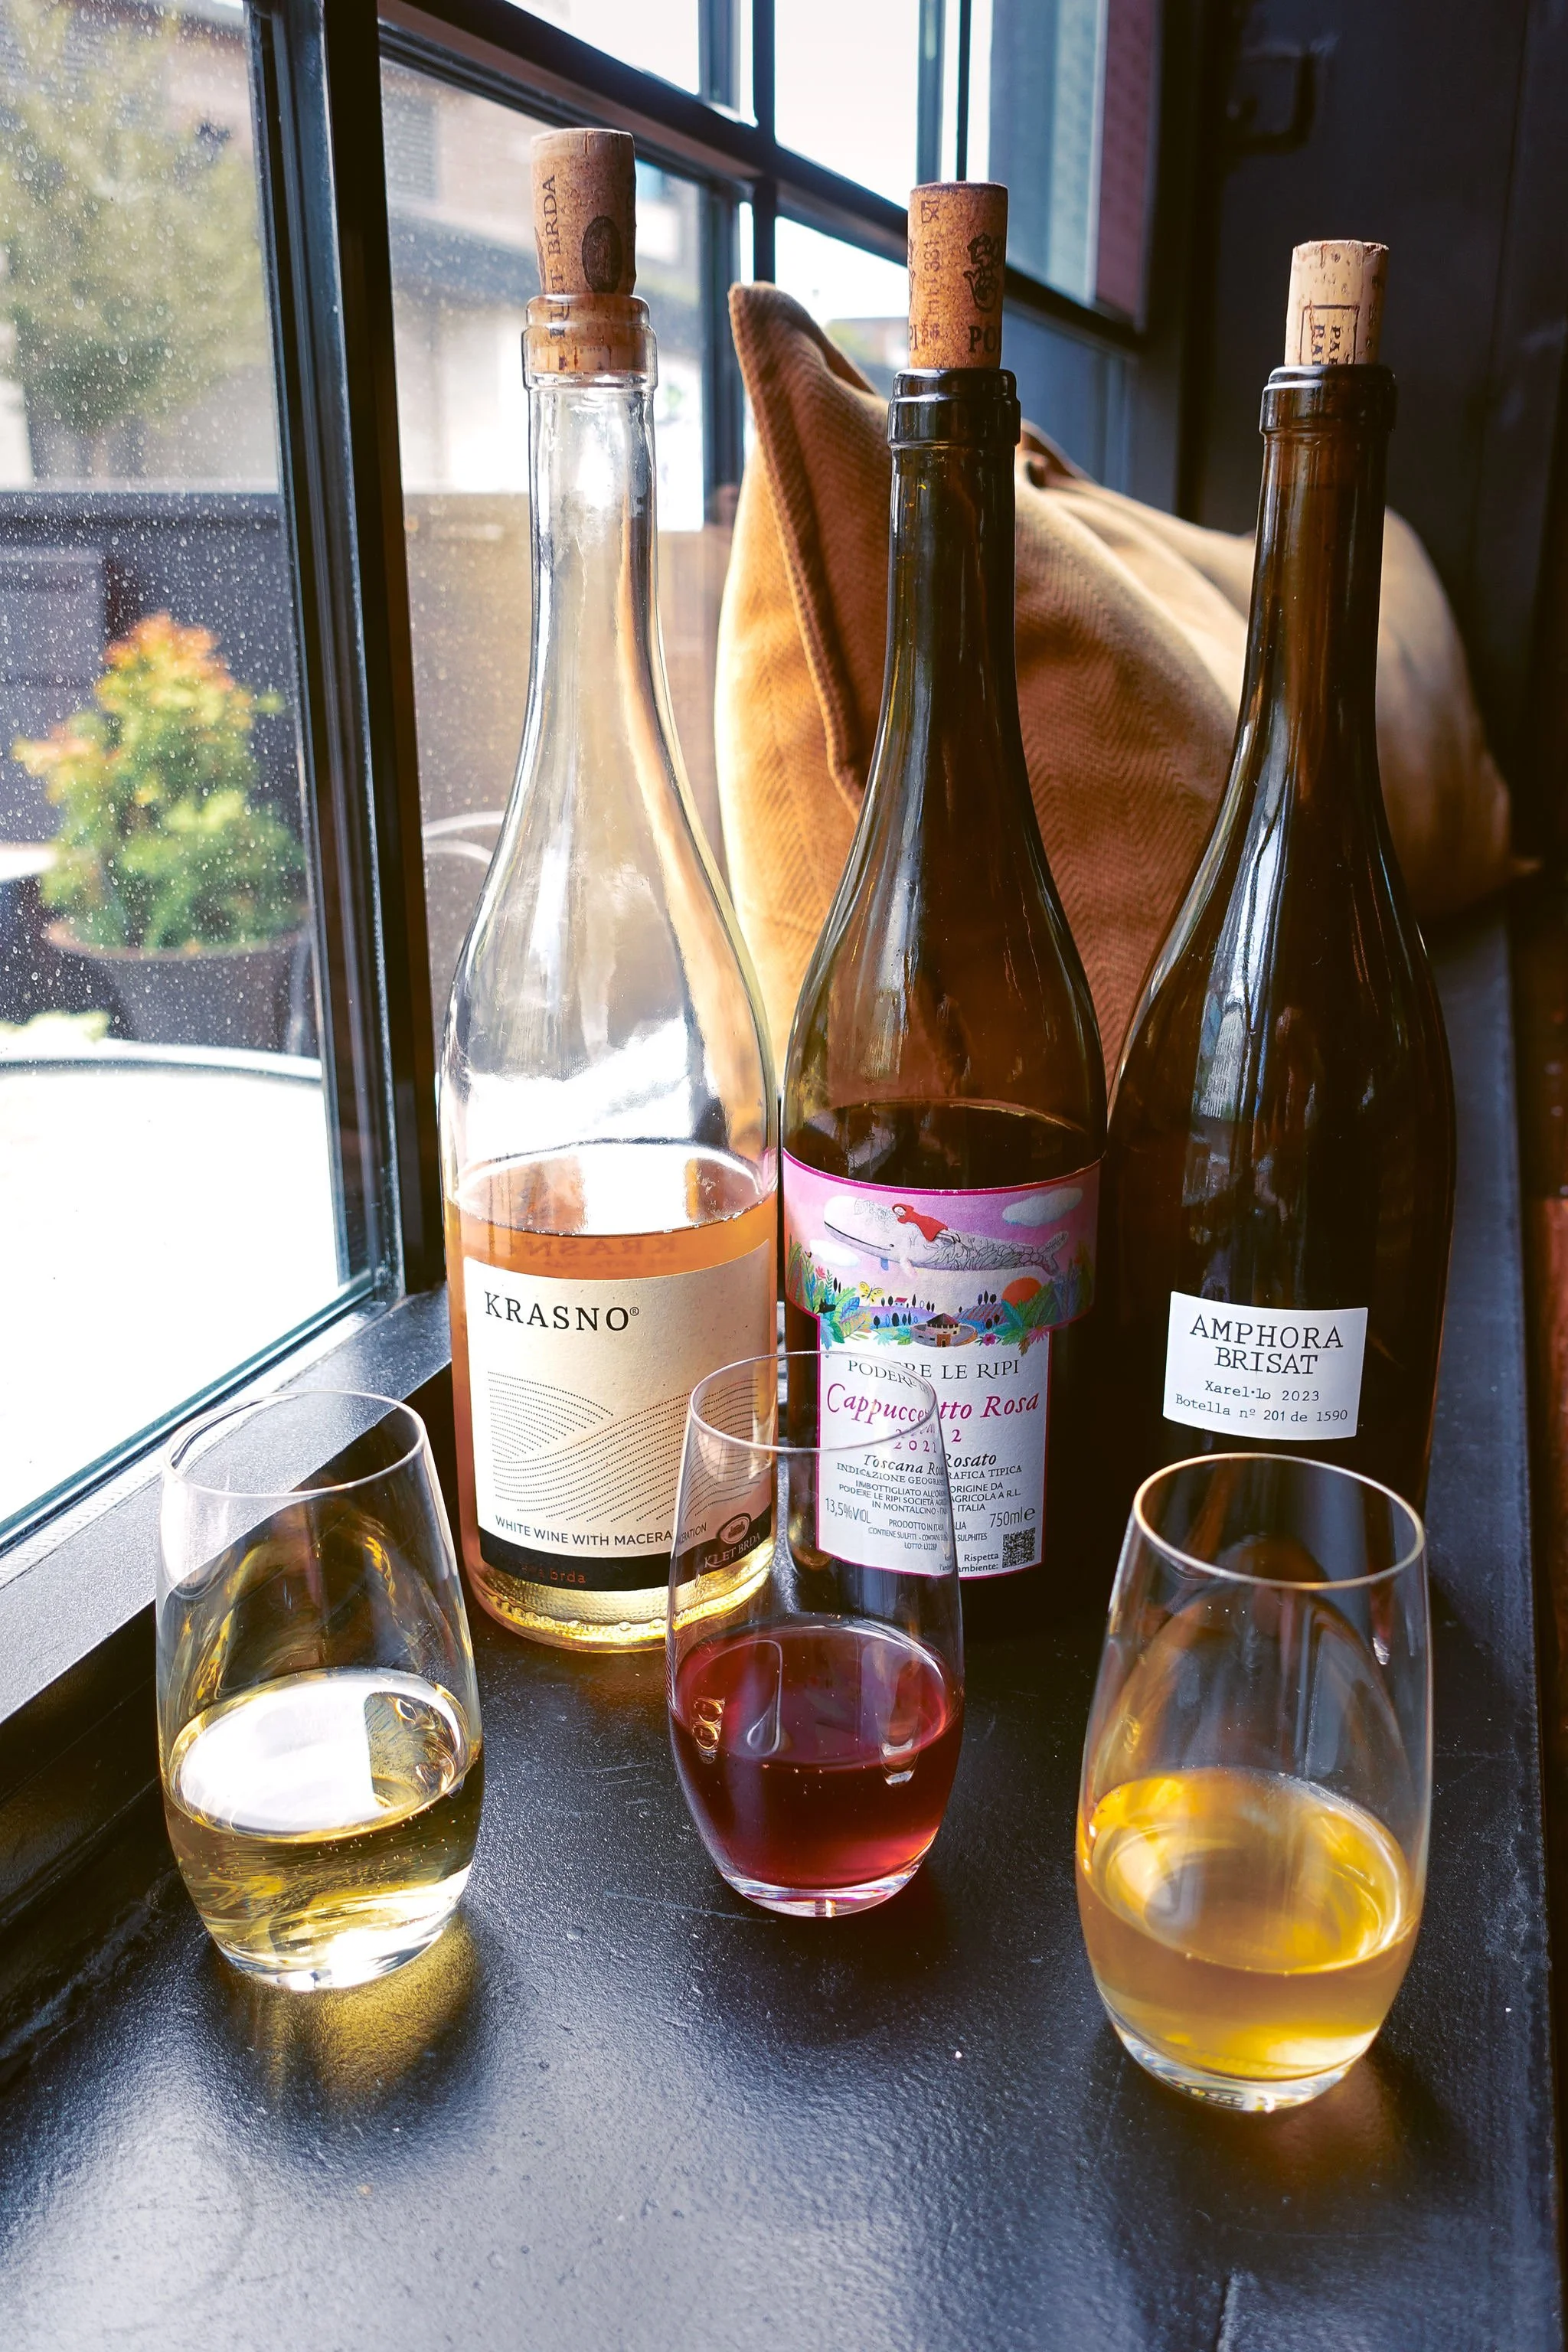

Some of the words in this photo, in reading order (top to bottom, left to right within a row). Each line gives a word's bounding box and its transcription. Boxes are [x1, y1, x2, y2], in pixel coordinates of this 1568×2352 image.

[541, 175, 562, 257] BRDA
[1189, 1313, 1344, 1350] AMPHORA
[941, 1364, 968, 1379] LE
[976, 1359, 1020, 1379] RIPI
[1214, 1345, 1318, 1375] BRISAT
[980, 1392, 1040, 1417] Rosa
[1282, 1390, 1320, 1402] 2023
[1175, 1393, 1231, 1416] Botella
[1263, 1409, 1285, 1422] 201
[1290, 1410, 1308, 1423] de
[1316, 1409, 1348, 1423] 1590
[837, 1462, 906, 1484] INDICAZIONE
[988, 1465, 1023, 1478] TIPICA
[864, 1454, 923, 1474] Toscana
[838, 1483, 872, 1498] PODERE
[885, 1495, 901, 1504] RIPI
[903, 1496, 936, 1506] SOCIETÀ
[855, 1480, 922, 1497] IMBOTTIGLIATO
[871, 1500, 881, 1508] IN
[883, 1502, 936, 1514] MONTALCINO
[957, 1503, 986, 1513] ITALIA
[495, 1514, 531, 1537] WHITE
[534, 1528, 569, 1544] WINE
[572, 1533, 609, 1546] WITH
[867, 1527, 897, 1539] CONTIENE
[956, 1533, 988, 1542] SULPHITES
[888, 1518, 926, 1530] PRODOTTO
[926, 1522, 934, 1531] IN
[704, 1547, 737, 1569] KLET
[738, 1531, 761, 1555] BRDA
[964, 1553, 999, 1563] Rispetta
[550, 1567, 586, 1584] brda
